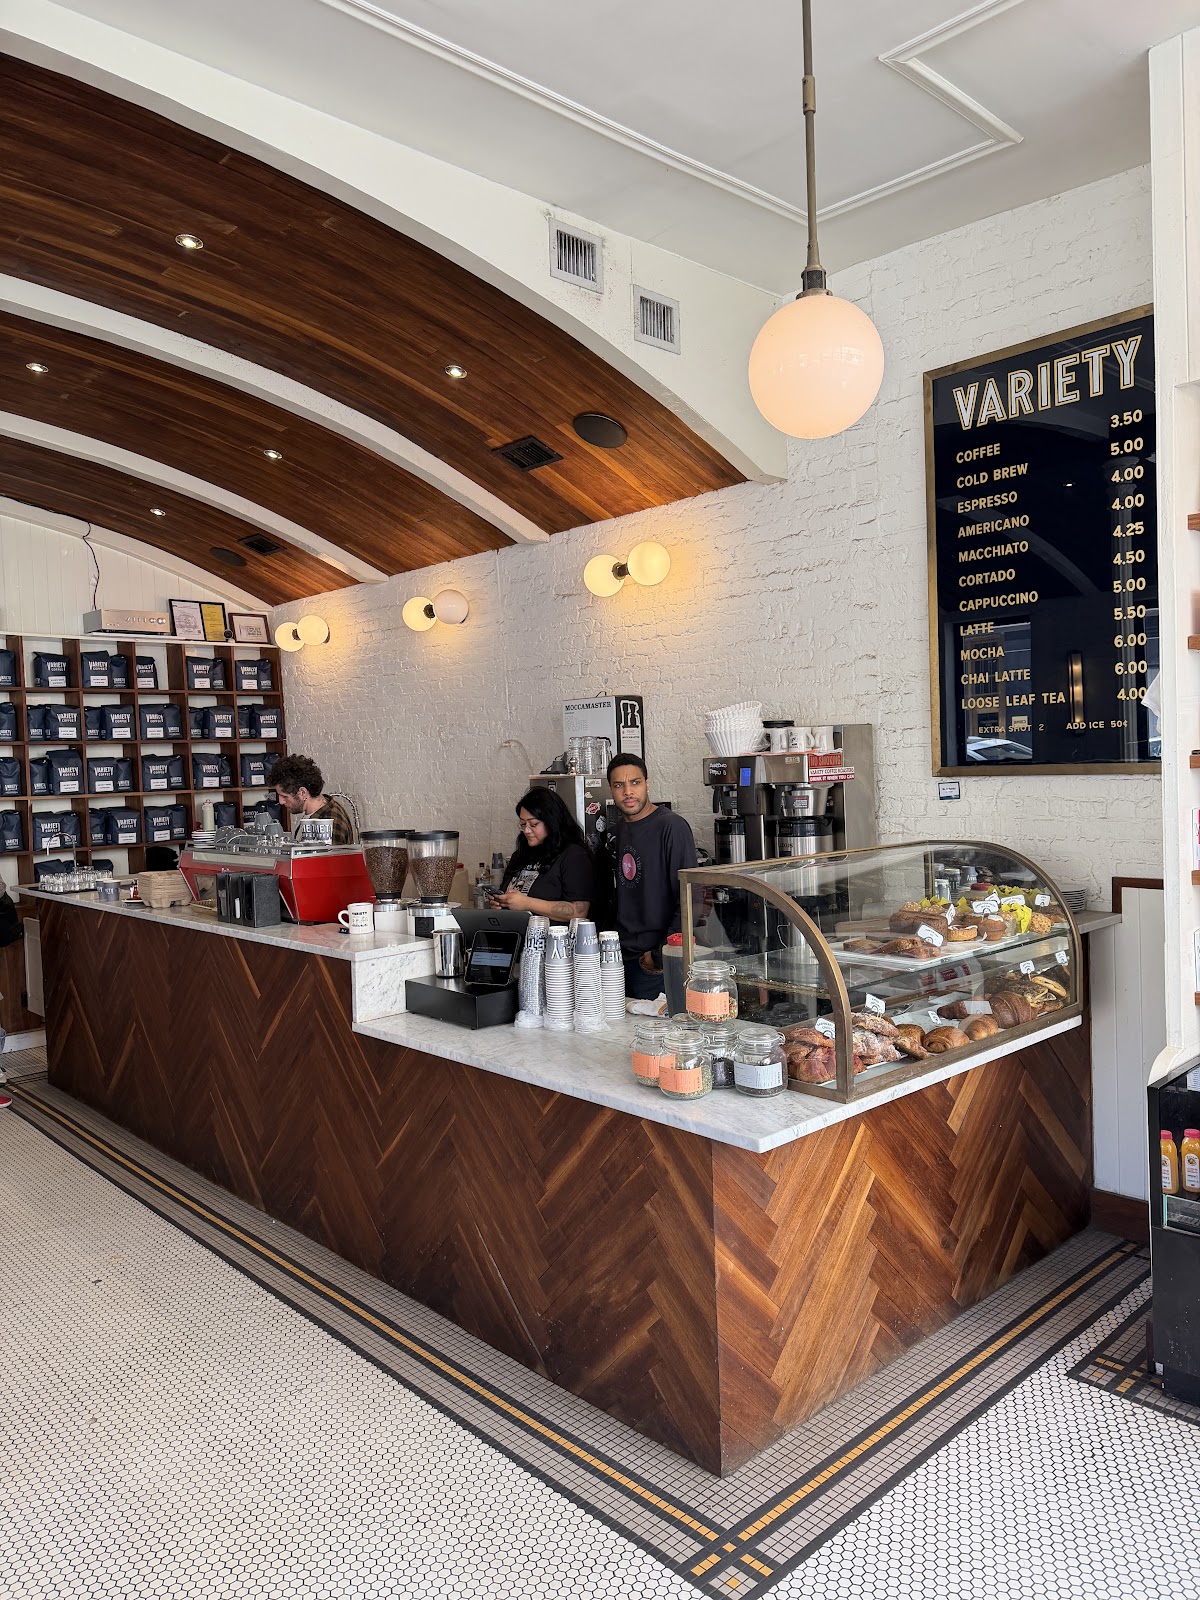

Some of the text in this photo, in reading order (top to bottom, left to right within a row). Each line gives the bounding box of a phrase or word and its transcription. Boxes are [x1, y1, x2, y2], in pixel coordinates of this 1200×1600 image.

[952, 335, 1142, 430] VARIETY
[956, 409, 1143, 463] COFFEE 3.50
[956, 437, 1144, 489] COLD BREW 5.00
[957, 465, 1144, 513] ESPRESSO 4.00
[957, 493, 1145, 538] AMERICANO 4.00
[958, 521, 1145, 563] MACCHIATO 4.25
[958, 549, 1146, 587] CORTADO 4.50
[959, 577, 1146, 612] CAPPUCCINO 5.00
[960, 605, 1146, 637] LATTE 5.50
[960, 632, 1147, 661] MOCHA 6.00
[47, 662, 66, 671] VARIETY
[961, 660, 1148, 685] CHAI LATTE 6.00
[565, 702, 612, 711] MOCCAMASTER
[961, 687, 1147, 709] LOOSE LEAF TEA 4.00
[57, 712, 77, 722] VARIETY
[110, 714, 130, 723] VARIETY
[978, 725, 1006, 734] EXTRA
[1008, 724, 1032, 733] SHOT
[1066, 721, 1086, 730] ADD
[1089, 720, 1105, 729] ICE
[58, 767, 78, 776] VARIETY
[94, 767, 113, 776] VARIETY
[149, 765, 168, 774] VARIETY
[810, 756, 818, 766] NO
[117, 819, 137, 828] VARIETY
[153, 817, 170, 826] VARIETY
